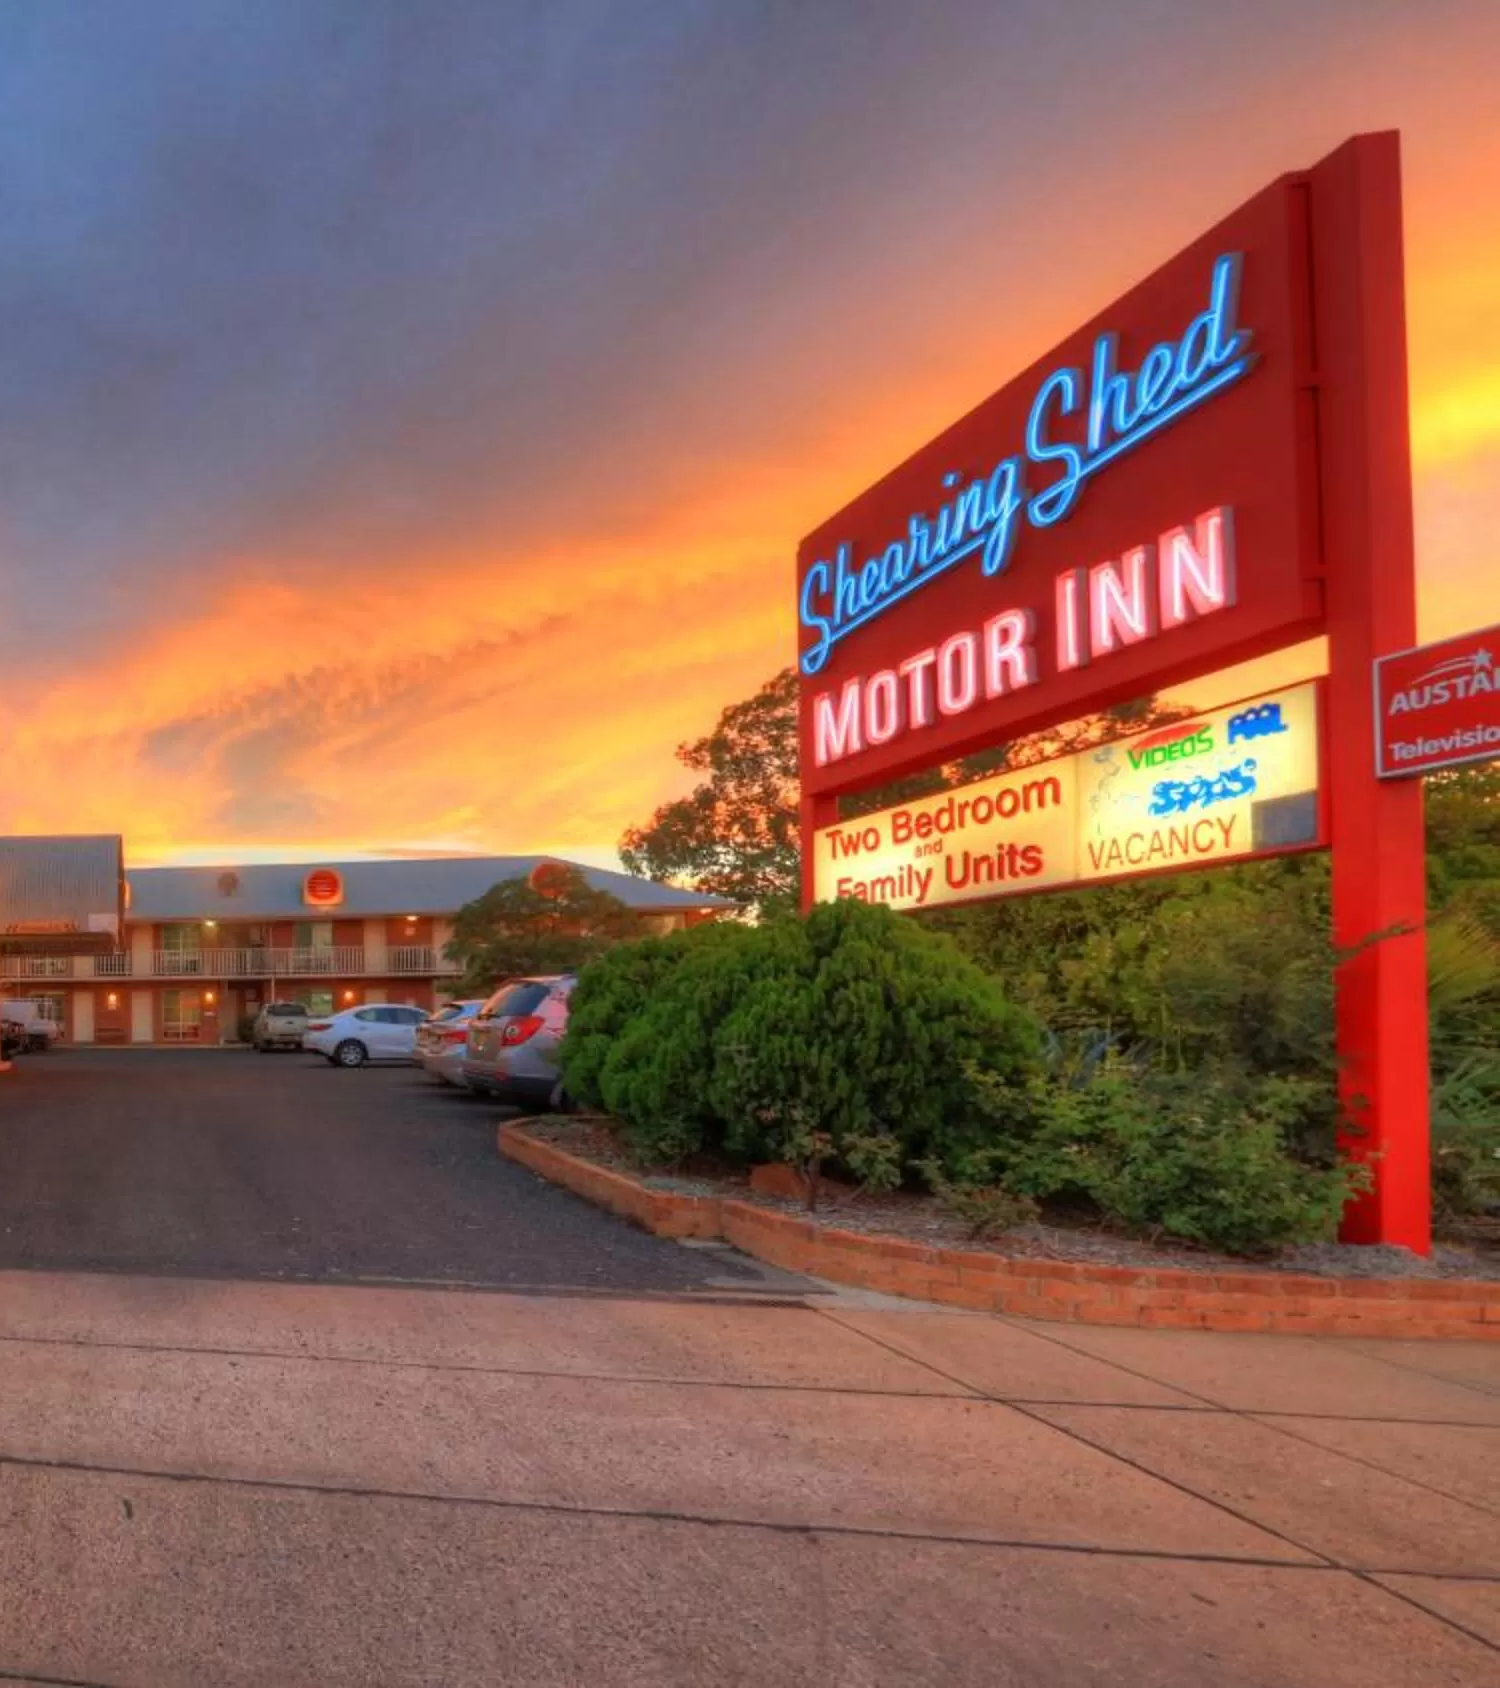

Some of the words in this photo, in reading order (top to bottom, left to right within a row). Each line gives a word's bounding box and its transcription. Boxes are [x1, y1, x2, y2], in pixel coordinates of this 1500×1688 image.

[800, 455, 1021, 675] Shearing
[1026, 252, 1254, 528] Shed
[813, 606, 1038, 769] MOTOR
[1056, 505, 1234, 673] INN
[1389, 667, 1500, 717] AUSTA
[1127, 724, 1214, 770] VIDEOS
[1227, 703, 1288, 745] POOL
[826, 826, 881, 861] Two
[891, 776, 1062, 846] Bedroom
[914, 837, 943, 859] and
[1087, 813, 1237, 871] VACANCY
[836, 862, 934, 904] Family
[945, 841, 1044, 890] Units
